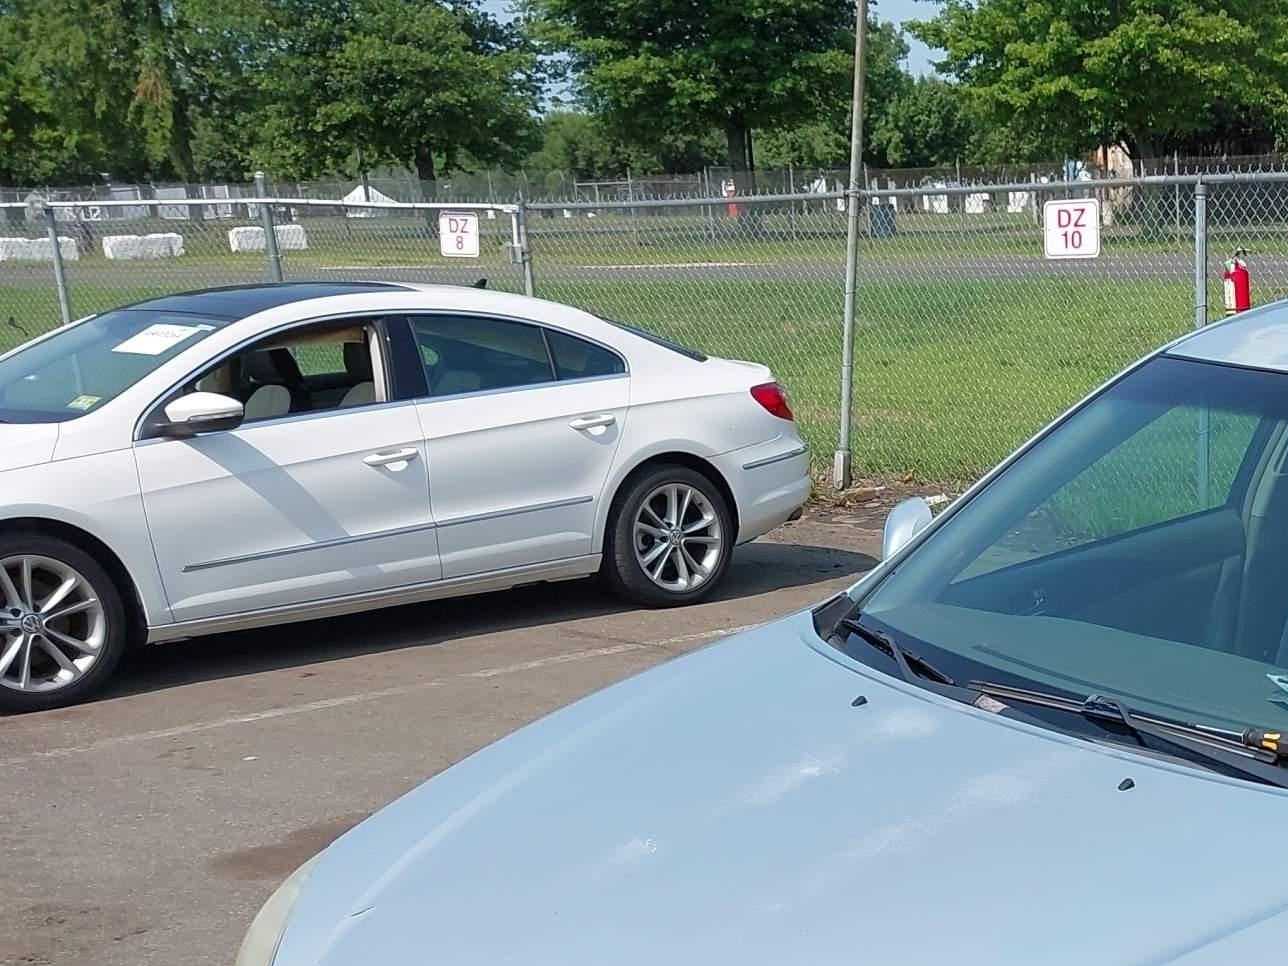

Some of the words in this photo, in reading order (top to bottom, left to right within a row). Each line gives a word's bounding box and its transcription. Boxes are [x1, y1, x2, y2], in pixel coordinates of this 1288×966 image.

[449, 218, 469, 233] DZ
[1057, 208, 1086, 228] DZ
[455, 235, 464, 250] 8
[1060, 230, 1083, 249] 10
